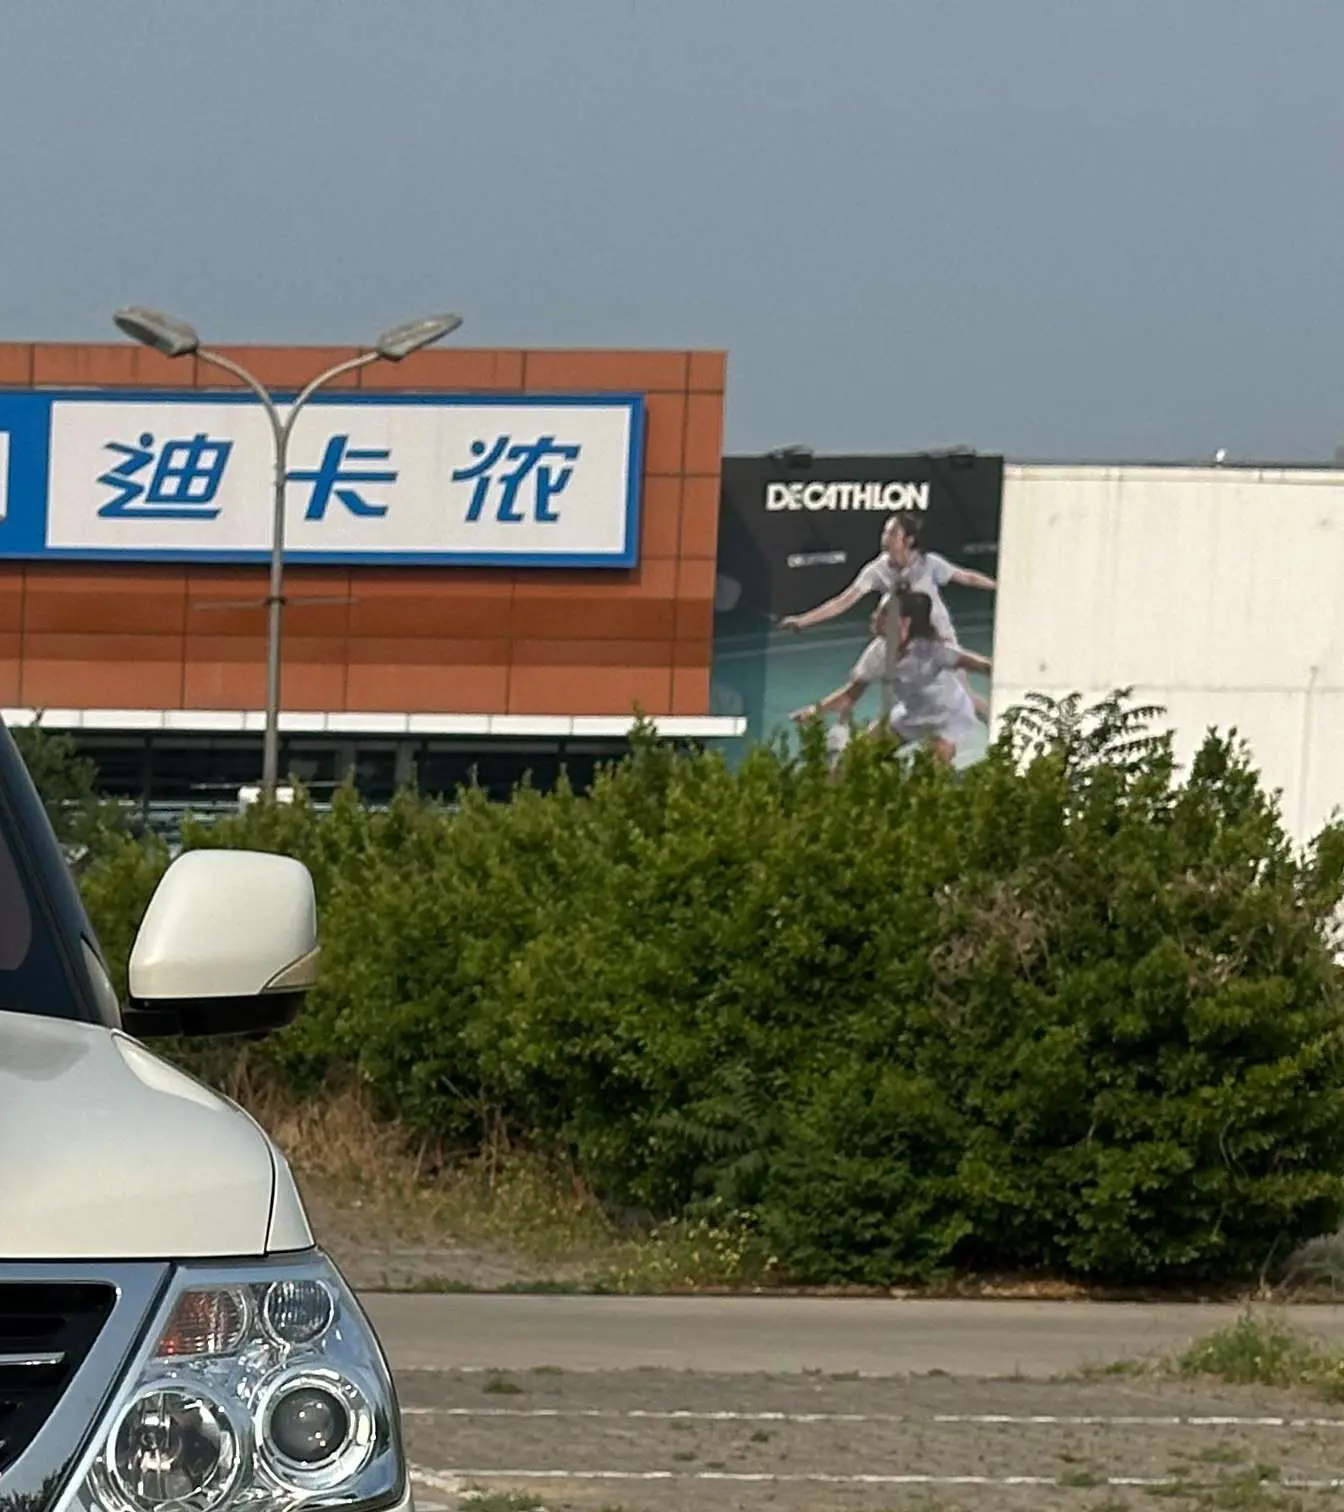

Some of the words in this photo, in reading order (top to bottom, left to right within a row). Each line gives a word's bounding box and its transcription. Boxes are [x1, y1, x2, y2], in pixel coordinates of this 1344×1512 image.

[96, 433, 581, 522] 迪卡侬
[765, 481, 930, 511] DECATHLON
